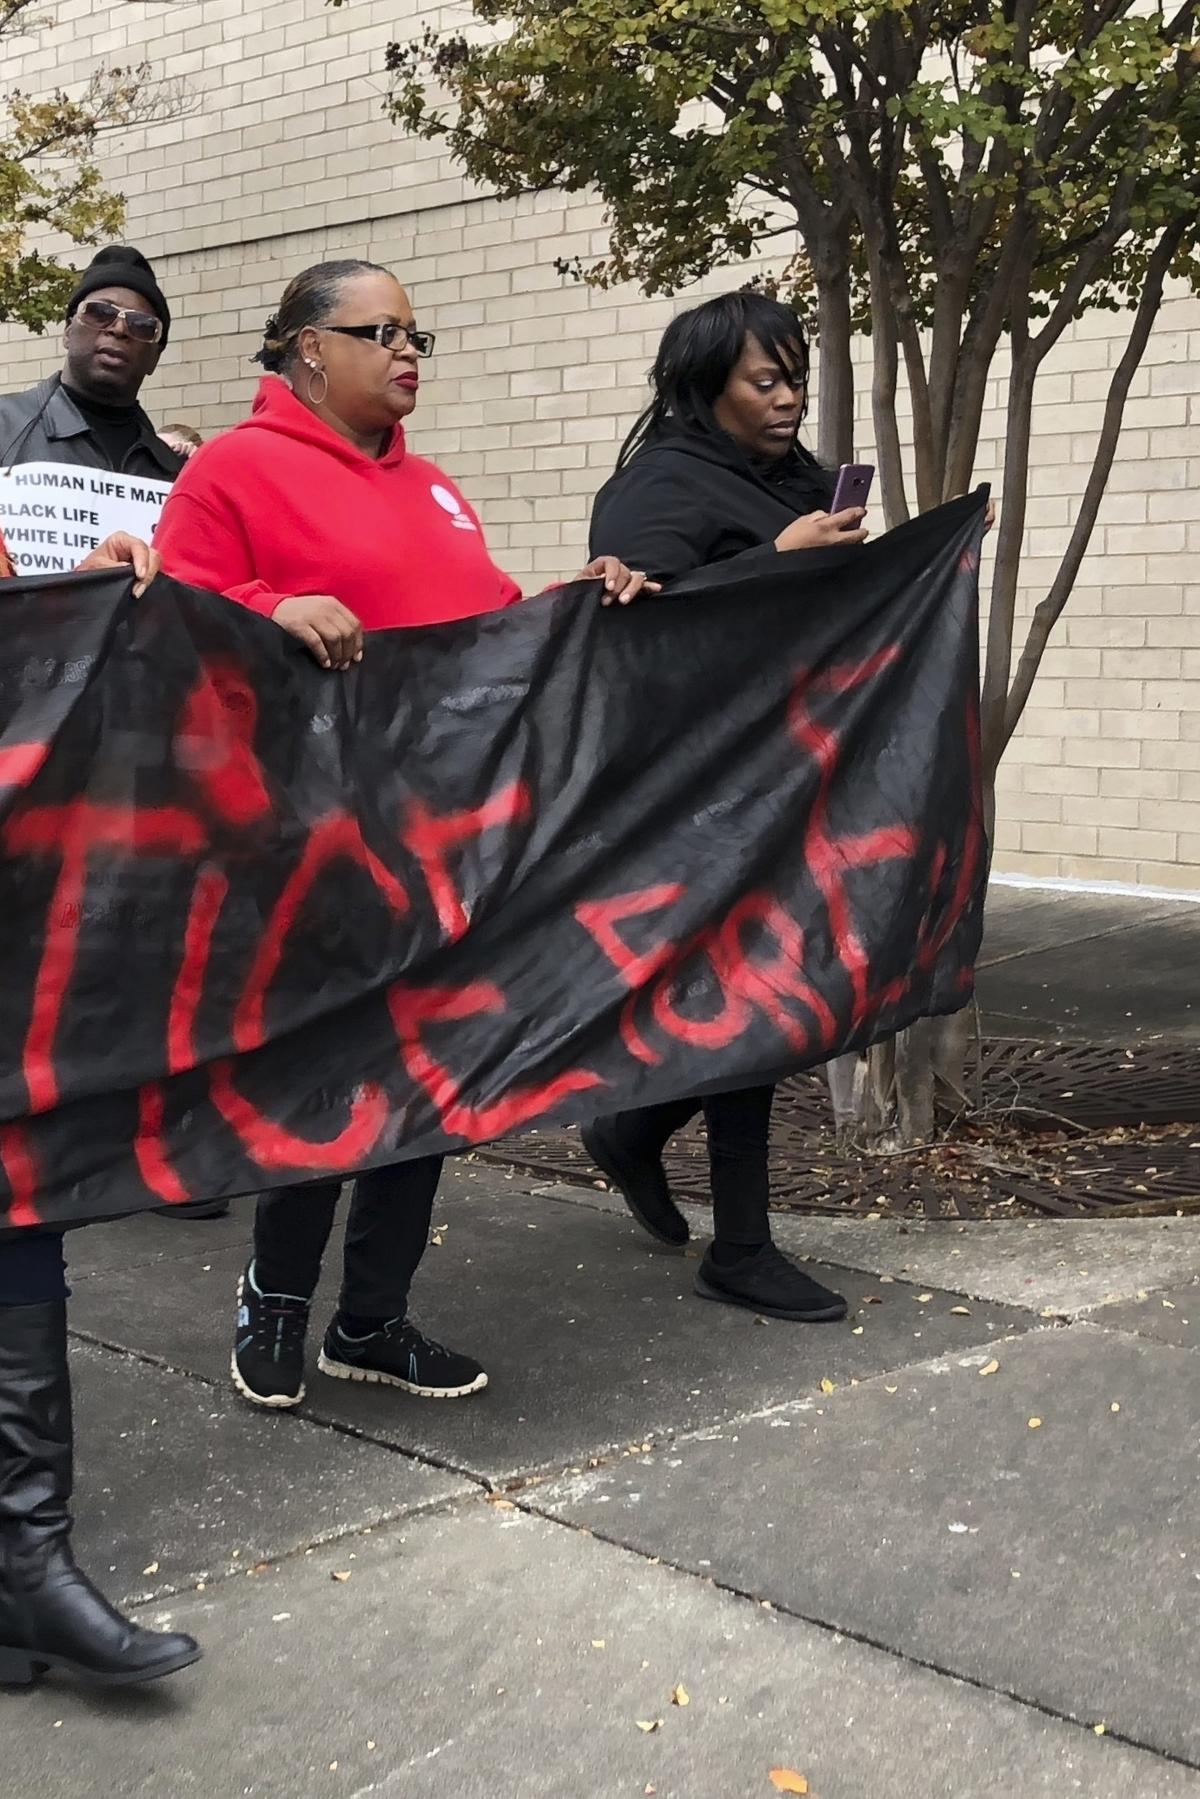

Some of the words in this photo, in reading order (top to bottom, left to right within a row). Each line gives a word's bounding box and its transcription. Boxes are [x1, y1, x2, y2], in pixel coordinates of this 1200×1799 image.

[15, 473, 85, 491] HUMAN
[90, 479, 125, 499] LIFE
[62, 507, 100, 526] LIFE
[63, 532, 100, 550] LIFE
